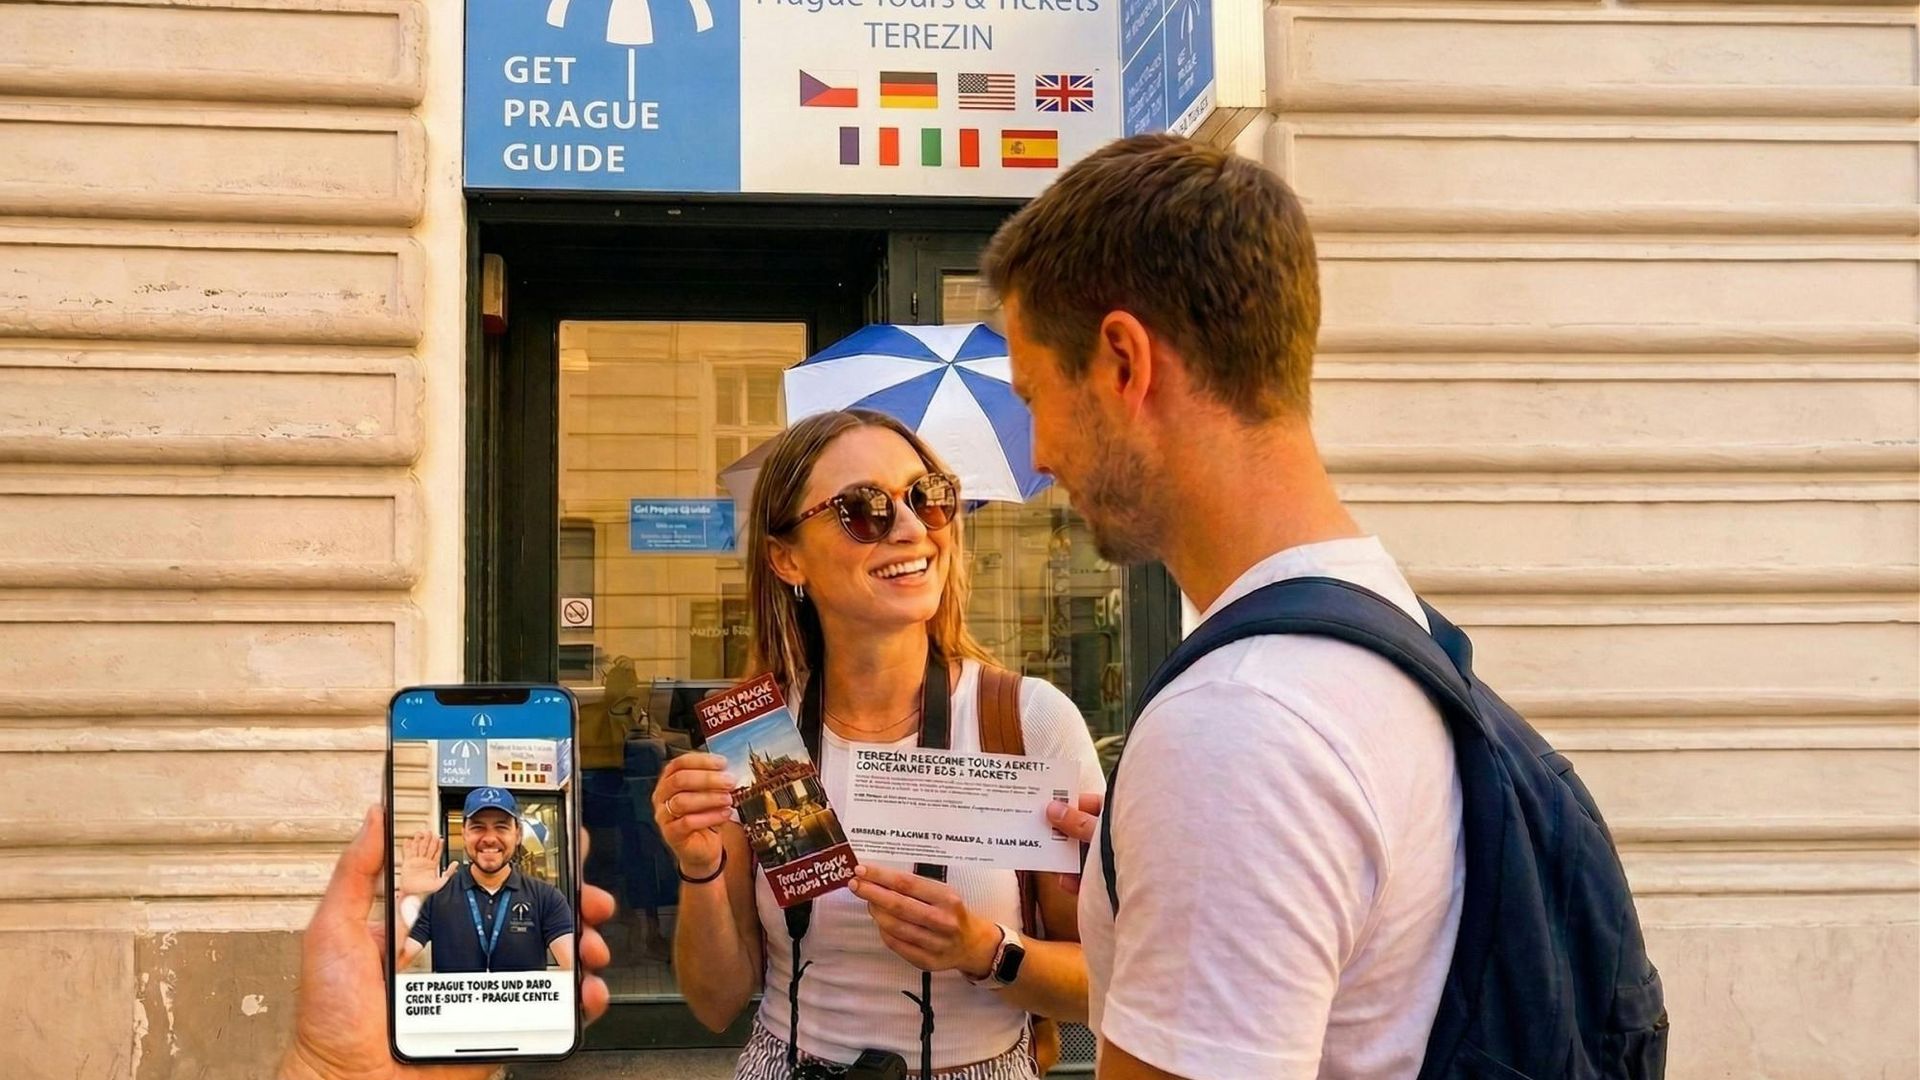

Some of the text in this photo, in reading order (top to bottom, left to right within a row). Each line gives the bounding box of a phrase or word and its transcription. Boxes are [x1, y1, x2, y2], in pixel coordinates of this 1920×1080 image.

[864, 22, 993, 50] TEREZIN
[503, 56, 576, 85] GET
[504, 99, 659, 129] PRAGUE
[503, 143, 625, 172] GUIDE
[857, 749, 907, 762] TEREZÍN
[968, 757, 1002, 769] TOURS
[405, 982, 425, 991] GET
[427, 981, 465, 991] PRAGUE
[467, 980, 499, 990] TOURS
[501, 979, 524, 990] UND
[482, 992, 520, 1003] PRAGUE
